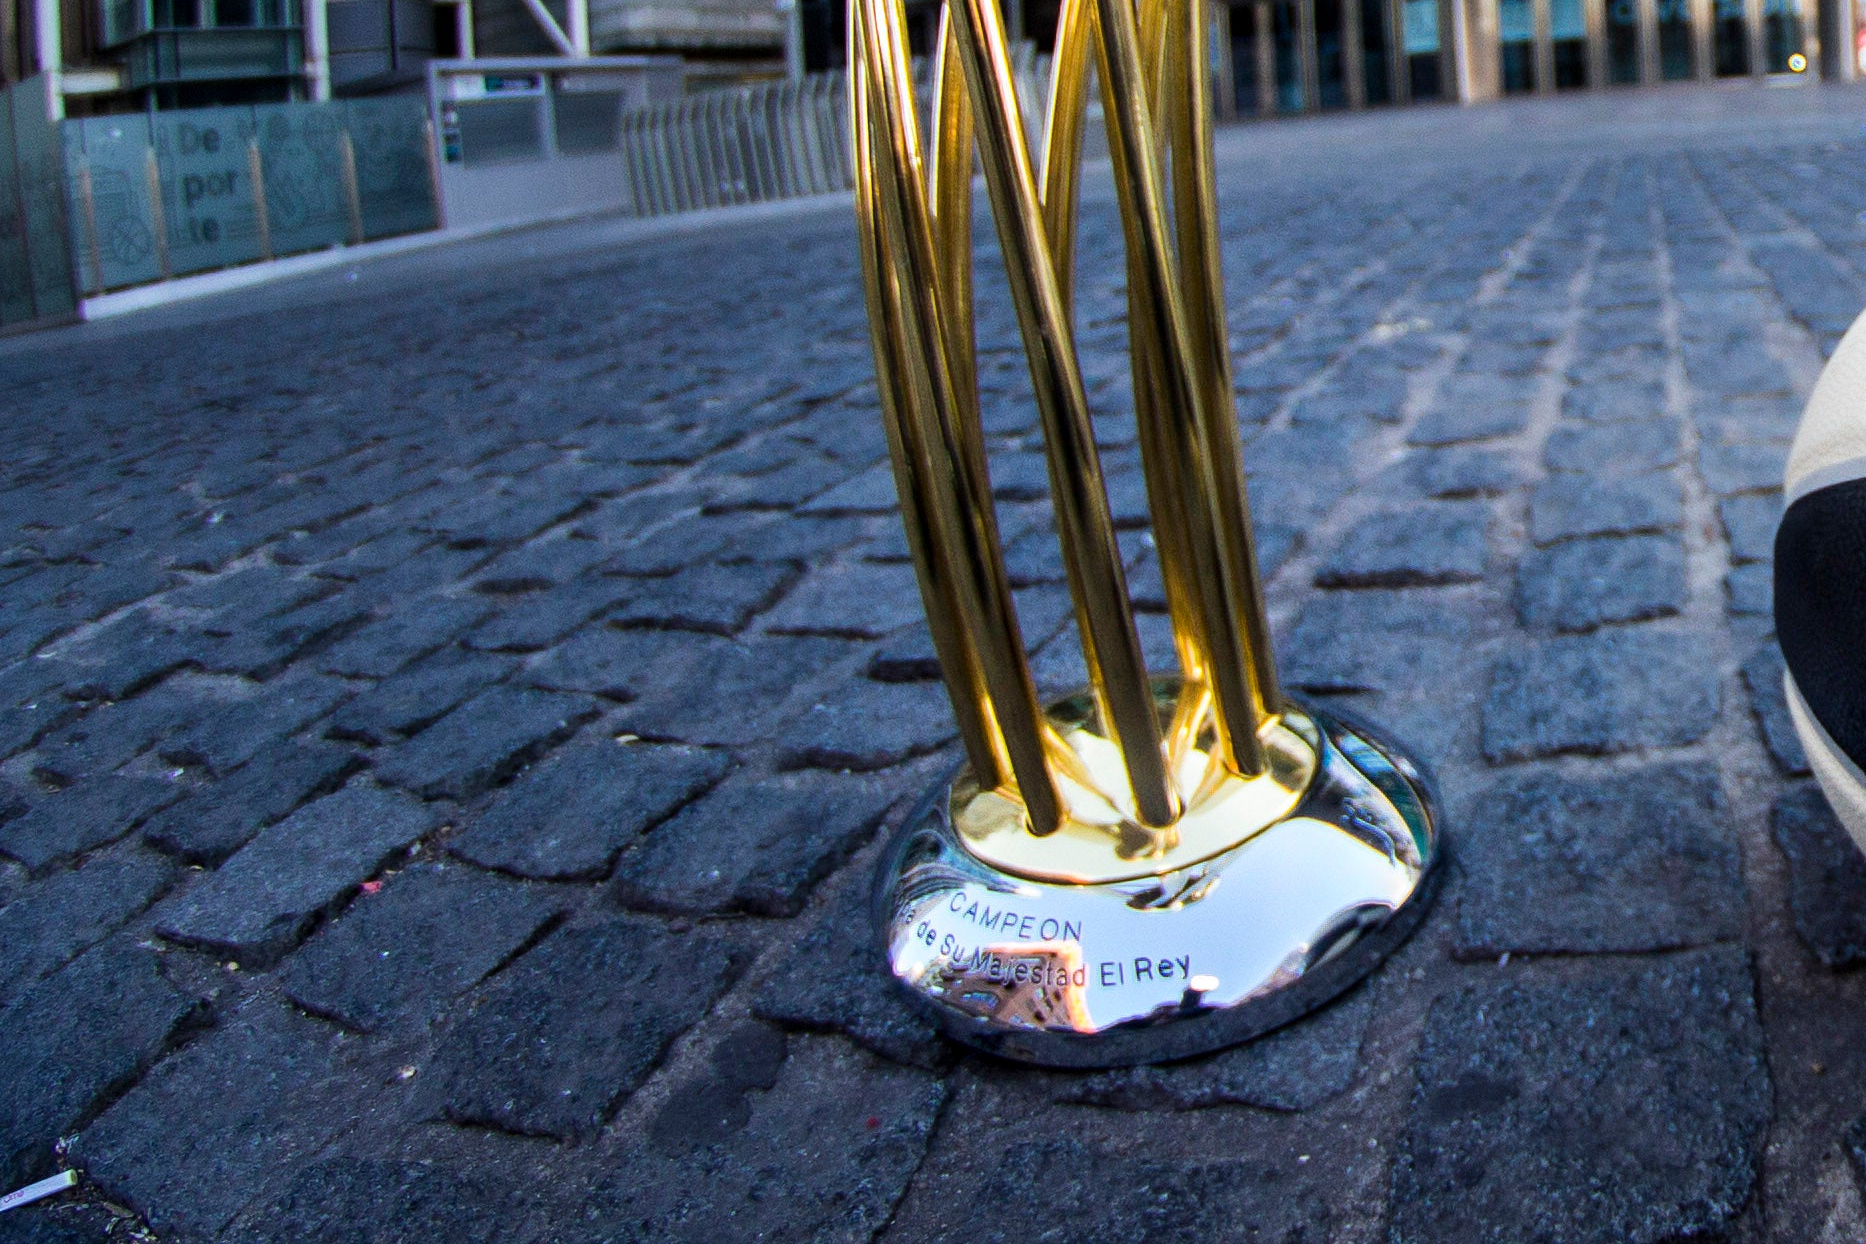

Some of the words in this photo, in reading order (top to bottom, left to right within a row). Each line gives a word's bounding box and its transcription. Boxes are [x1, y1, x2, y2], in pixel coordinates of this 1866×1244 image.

[183, 169, 239, 208] por
[949, 891, 1082, 943] CAMPEON
[916, 918, 937, 947] de
[940, 933, 966, 963] Su
[969, 945, 1088, 987] Majestad
[1100, 961, 1125, 987] El
[1134, 955, 1190, 981] Rey
